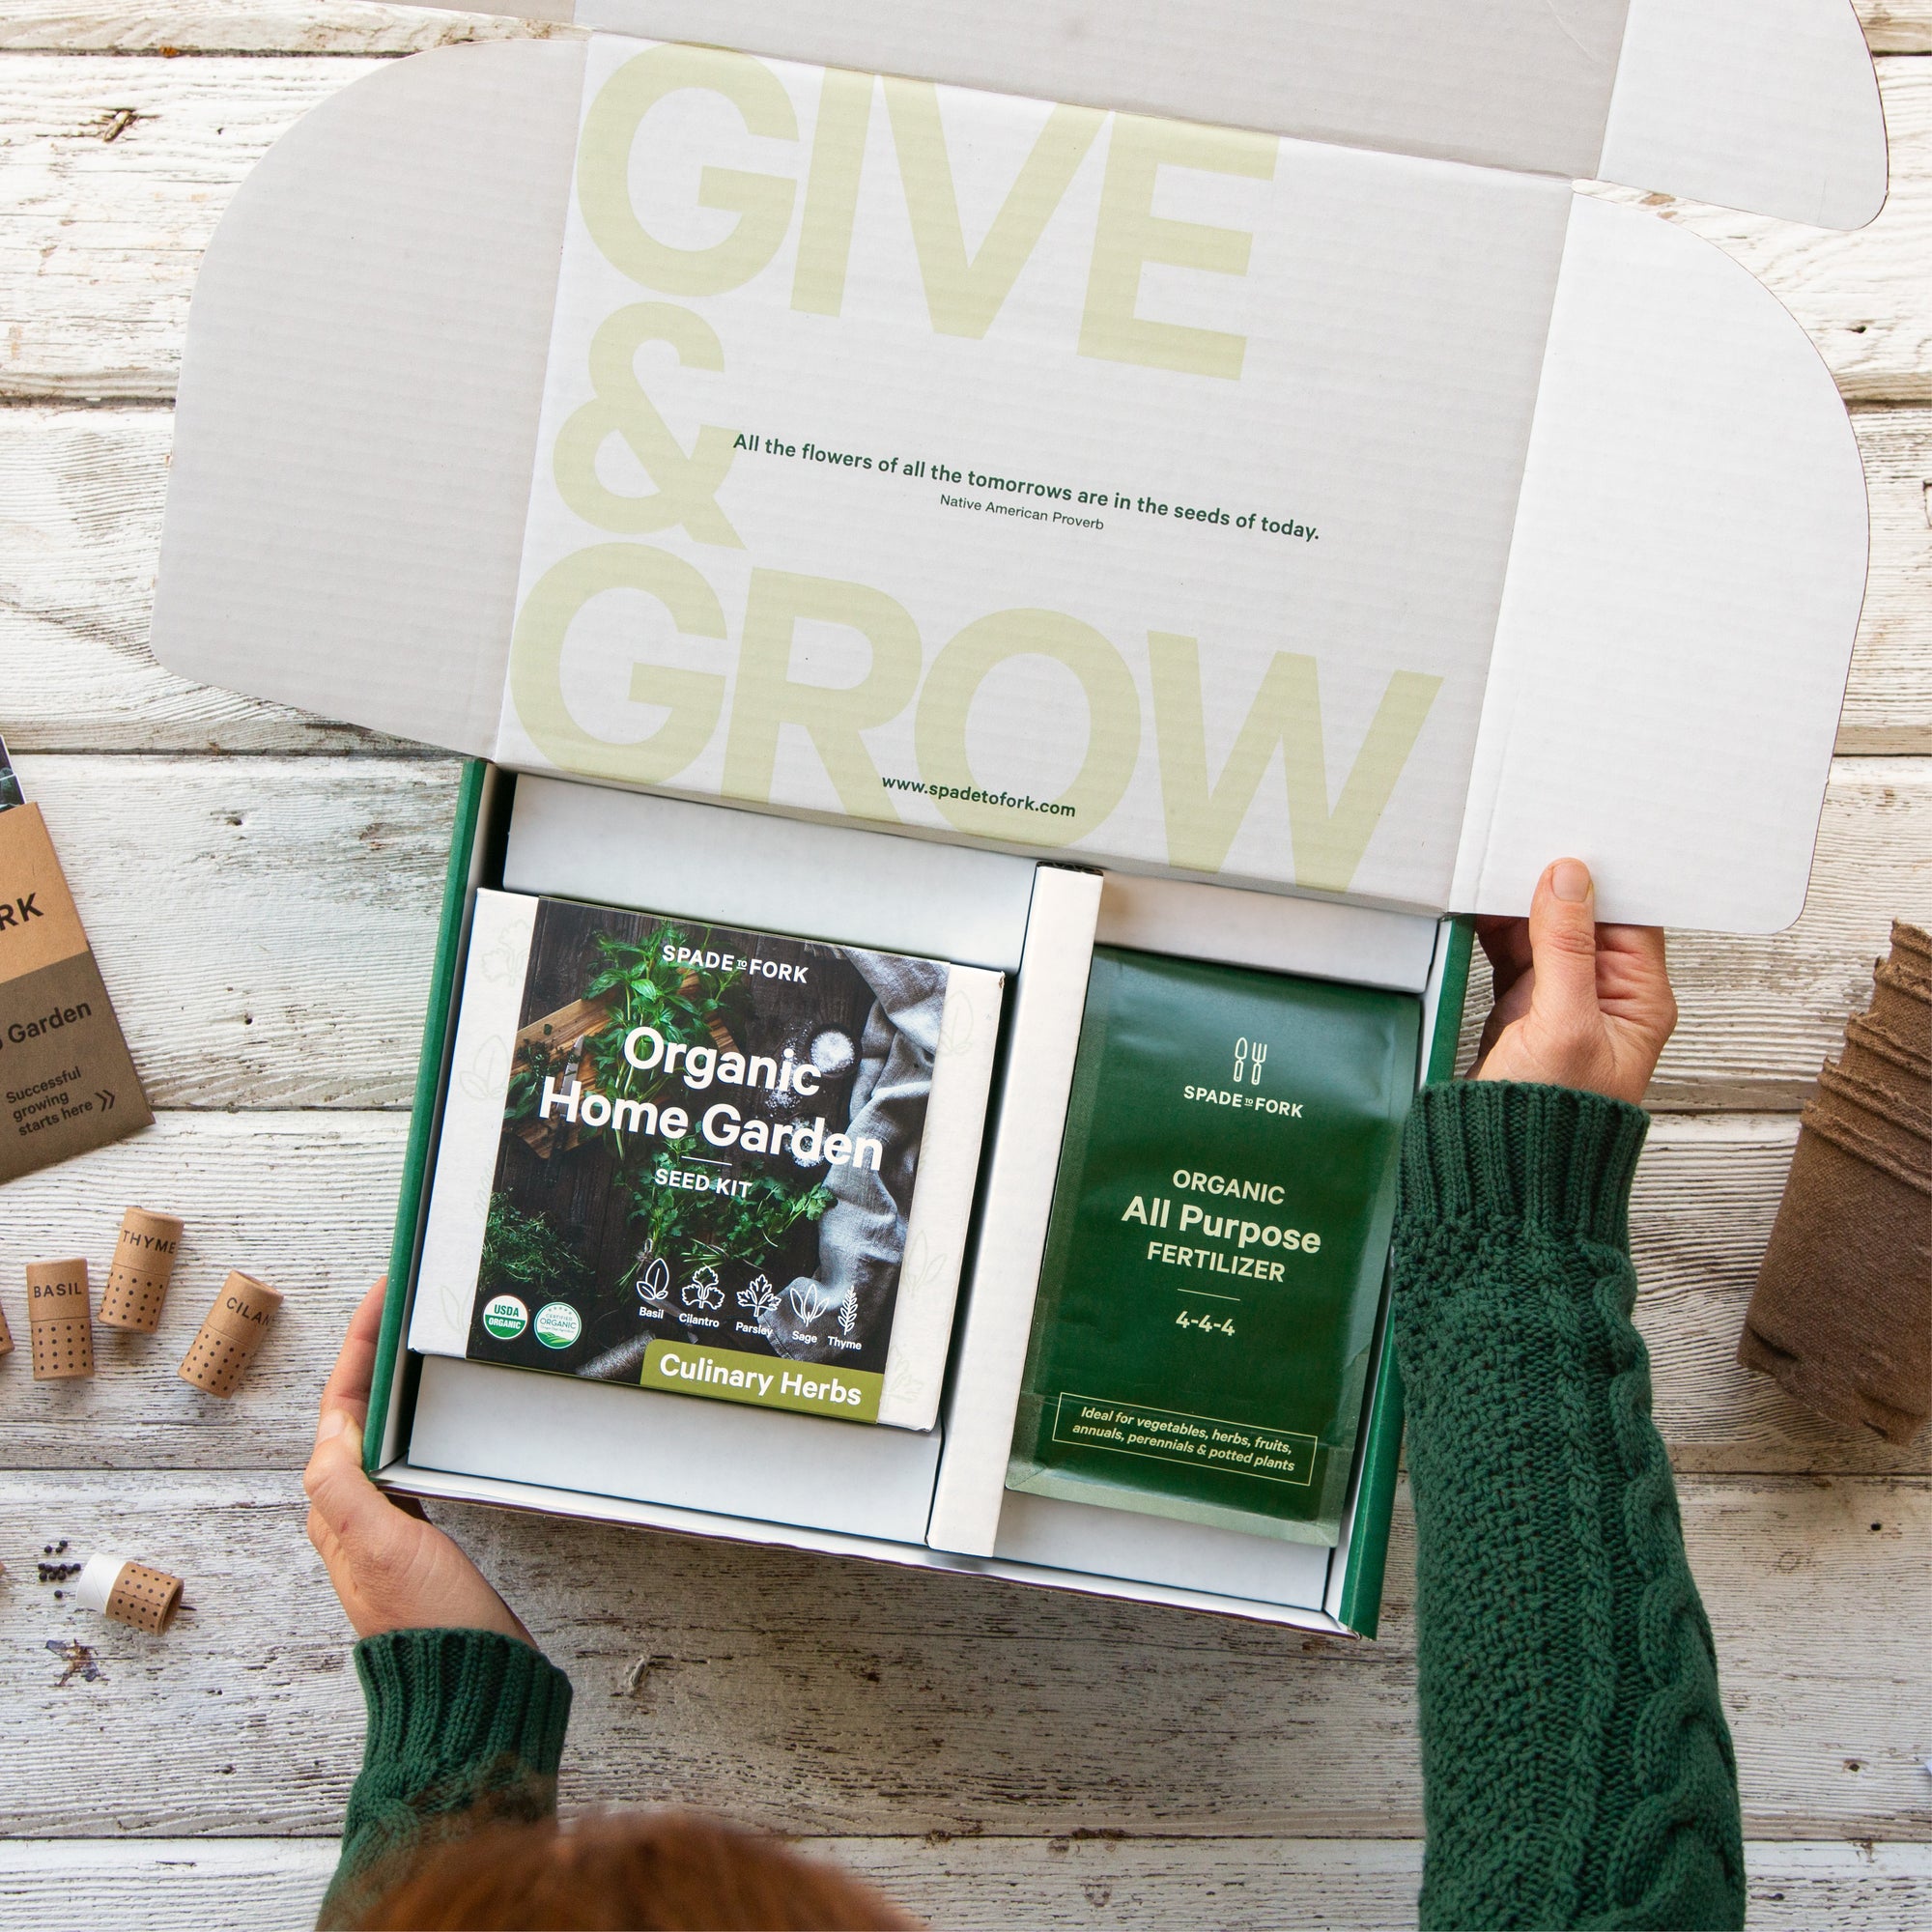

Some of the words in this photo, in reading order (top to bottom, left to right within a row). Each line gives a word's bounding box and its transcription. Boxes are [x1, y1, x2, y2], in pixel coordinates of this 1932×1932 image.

[577, 43, 1279, 381] GIVE
[553, 301, 747, 551] &
[733, 434, 759, 451] All
[765, 439, 796, 457] the
[802, 443, 872, 469] flowers
[878, 457, 899, 473] of
[903, 461, 925, 478] all
[930, 465, 962, 483] the
[968, 470, 1072, 500] tomorrows
[1077, 490, 1108, 505] are
[1114, 493, 1131, 510] in
[1137, 497, 1169, 515] the
[1174, 505, 1230, 526] seeds
[1236, 513, 1257, 529] of
[1262, 517, 1320, 542] today.
[940, 494, 981, 511] Native
[985, 501, 1048, 522] American
[1052, 512, 1104, 530] Proverb
[509, 542, 1444, 893] GROW
[882, 777, 1075, 817] www.spadetofork.com
[662, 944, 735, 972] SPADE
[737, 959, 748, 969] TO
[749, 958, 810, 983] FORK
[8, 1002, 93, 1044] Garden
[624, 1026, 821, 1096] Organic
[6, 1065, 82, 1104] Successful
[1183, 1085, 1243, 1108] SPADE
[1255, 1096, 1304, 1119] FORK
[13, 1091, 70, 1122] growing
[18, 1114, 60, 1136] starts
[62, 1098, 94, 1122] here
[539, 1075, 689, 1140] Home
[701, 1103, 883, 1171] Garden
[654, 1168, 710, 1192] SEED
[716, 1177, 753, 1199] KIT
[1173, 1169, 1286, 1205] ORGANIC
[122, 1230, 177, 1254] THYME
[1122, 1195, 1171, 1229] All
[1179, 1204, 1321, 1254] Purpose
[1147, 1241, 1286, 1283] FERTILIZER
[34, 1282, 82, 1298] BASIL
[488, 1317, 522, 1329] ORGANIC
[494, 1304, 519, 1317] USDA
[540, 1318, 577, 1330] ORGANIC
[639, 1306, 664, 1320] Basil
[678, 1313, 720, 1328] Cilantro
[735, 1321, 773, 1337] Parsley
[1175, 1311, 1236, 1336] 4-4-4
[792, 1331, 817, 1345] Sage
[828, 1336, 863, 1350] Thyme
[660, 1353, 775, 1397] Culinary
[781, 1371, 863, 1406] Herbs
[1072, 1423, 1125, 1442] annuals,
[1126, 1433, 1195, 1454] perennials
[1197, 1444, 1207, 1456] &
[1208, 1446, 1253, 1464] potted
[1254, 1454, 1295, 1471] plants
[1081, 1406, 1114, 1422] Ideal
[1114, 1411, 1135, 1426] for
[1137, 1417, 1209, 1440] vegetables,
[1211, 1429, 1252, 1448] herbs,
[1254, 1436, 1293, 1456] fruits,
